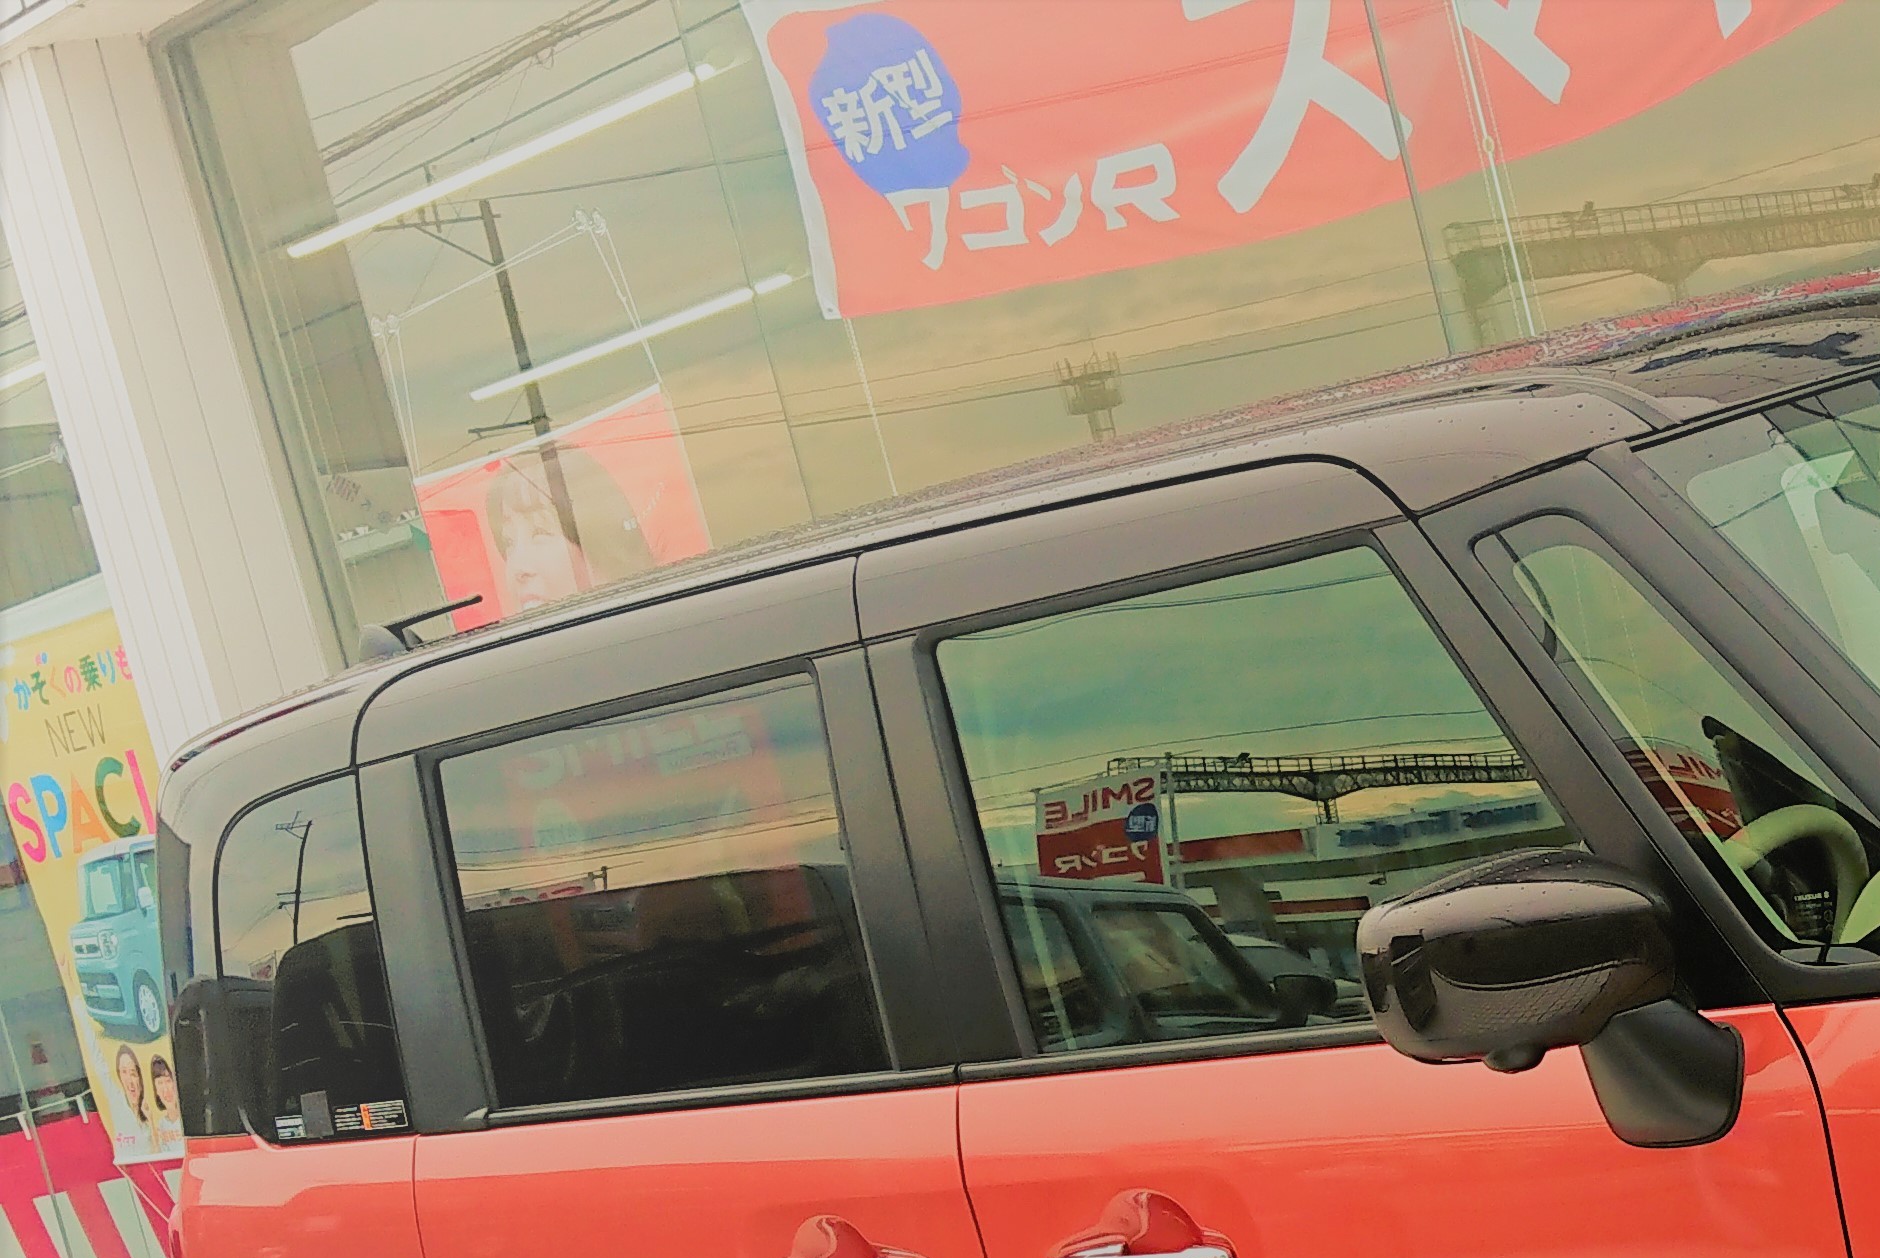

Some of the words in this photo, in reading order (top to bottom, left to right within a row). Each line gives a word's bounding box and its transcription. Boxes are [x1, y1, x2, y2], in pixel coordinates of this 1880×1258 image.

[820, 48, 953, 163] 新型
[883, 143, 1181, 271] ワゴンR
[44, 703, 106, 757] NEW
